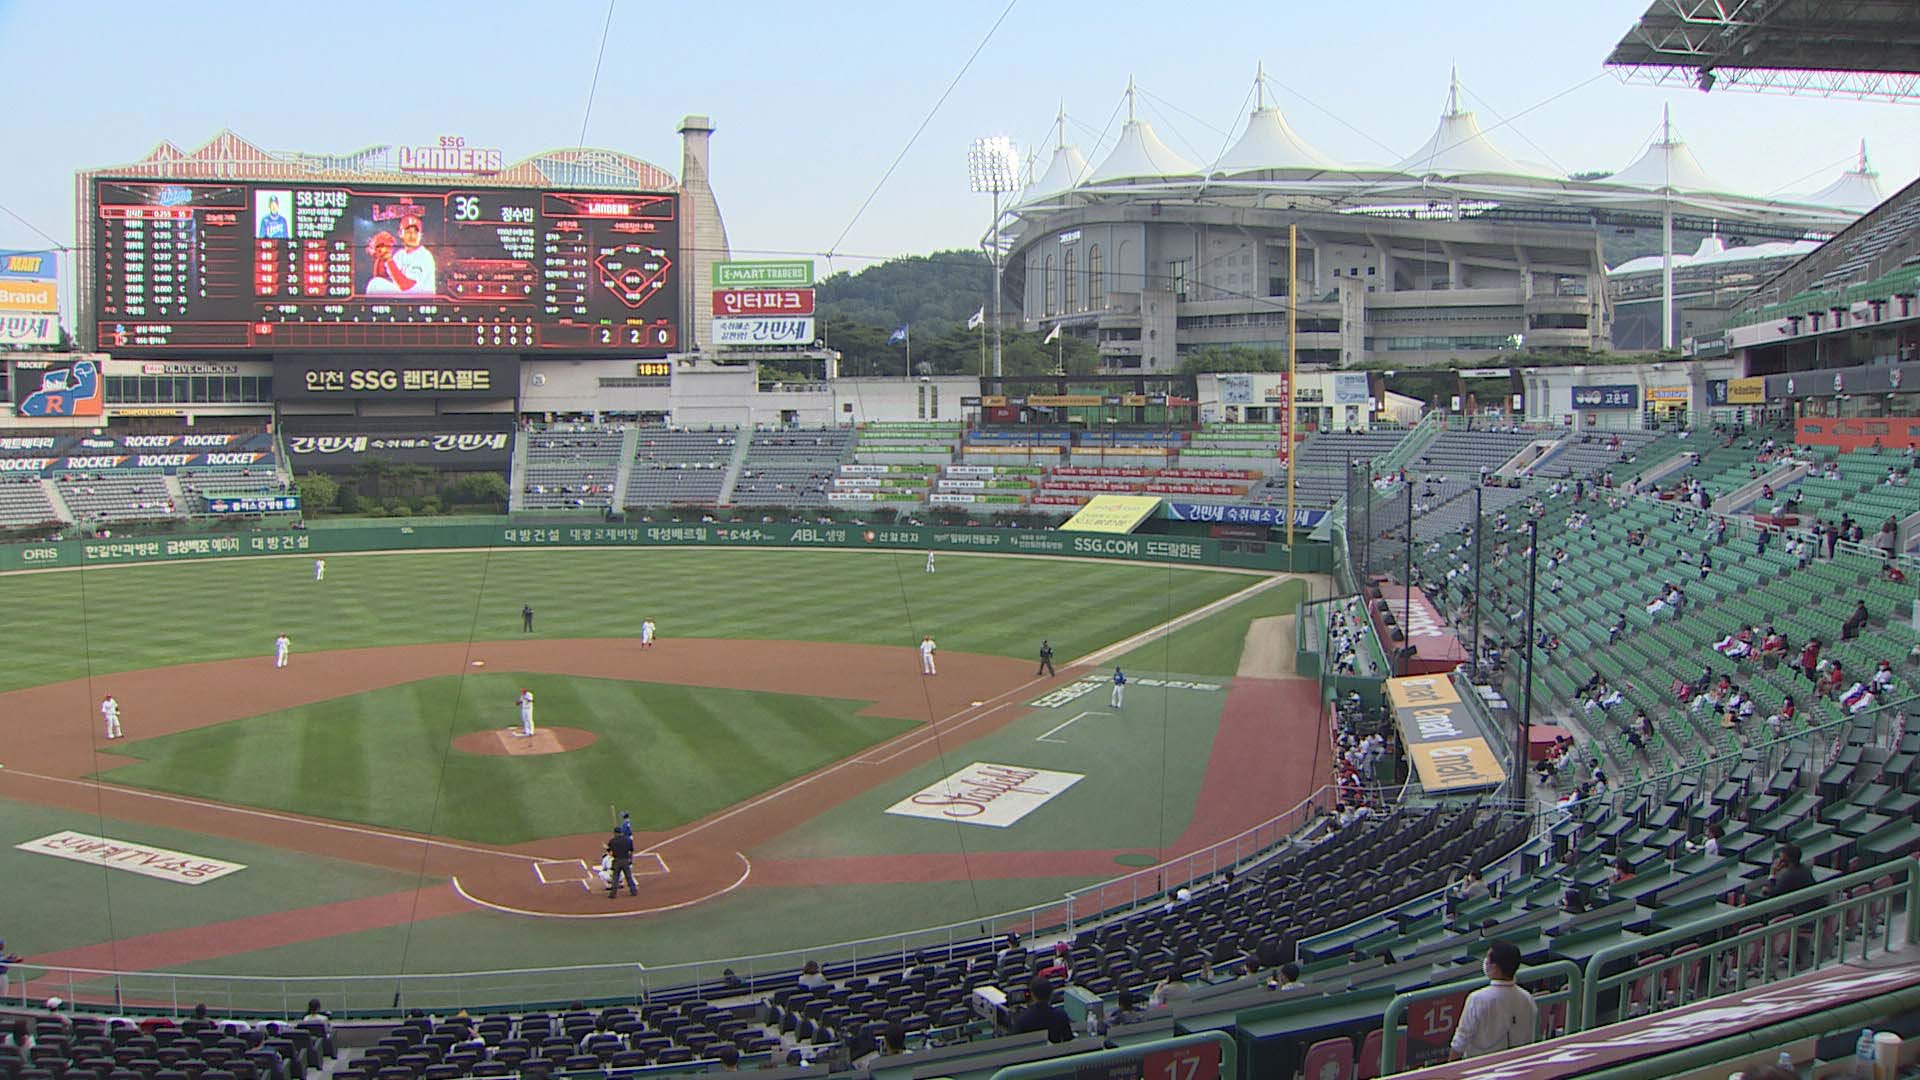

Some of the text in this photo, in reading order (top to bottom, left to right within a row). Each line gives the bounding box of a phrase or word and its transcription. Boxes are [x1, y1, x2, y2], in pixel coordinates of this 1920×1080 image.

[440, 136, 465, 147] SSG
[400, 147, 501, 171] LANDERS
[297, 192, 347, 207] 58 김지찬
[456, 197, 480, 220] 36
[502, 207, 534, 222] 정수민
[588, 203, 630, 215] LANDERS
[290, 252, 296, 260] 0
[290, 264, 296, 272] 9
[724, 268, 802, 279] E-MART TRADERS
[288, 274, 298, 283] 20
[501, 285, 507, 293] 2
[524, 285, 531, 293] 0
[724, 293, 802, 313] 인터파크
[0, 318, 48, 339] 만세
[478, 326, 484, 334] 0
[494, 326, 500, 334] 0
[510, 326, 516, 334] 0
[526, 326, 532, 334] 0
[752, 321, 806, 341] 간만세
[478, 336, 484, 344] 0
[494, 336, 500, 344] 0
[510, 336, 516, 344] 0
[526, 336, 532, 344] 0
[602, 330, 667, 344] 2 2 0
[166, 364, 194, 374] OLIVE
[195, 364, 237, 374] CHICKEN
[639, 364, 669, 375] 18:31
[306, 370, 490, 390] 인천 SSG 랜더스필드
[125, 436, 174, 447] ROCKET
[184, 435, 231, 446] ROCKET
[291, 434, 508, 453] 간만세 숙취해소 간만세
[0, 453, 258, 470] ROCKET ROCKET ROCKET ROCKET
[1190, 505, 1224, 521] 간만세
[1228, 508, 1271, 521] 숙취해소
[505, 528, 560, 542] 대방건설
[791, 529, 846, 542] ABL 생명
[167, 537, 240, 555] 금성백조 예미지
[252, 536, 309, 550] 대방건설
[1074, 538, 1138, 554] SSG.COM
[1146, 542, 1201, 558] 도드람한돈
[24, 549, 58, 560] ORIS
[86, 542, 159, 560] 한길안과병원
[1413, 708, 1463, 739] emart
[1429, 746, 1485, 783] emart
[912, 766, 1050, 817] Starfield
[1423, 1005, 1454, 1036] 15
[1164, 1055, 1200, 1080] 17
